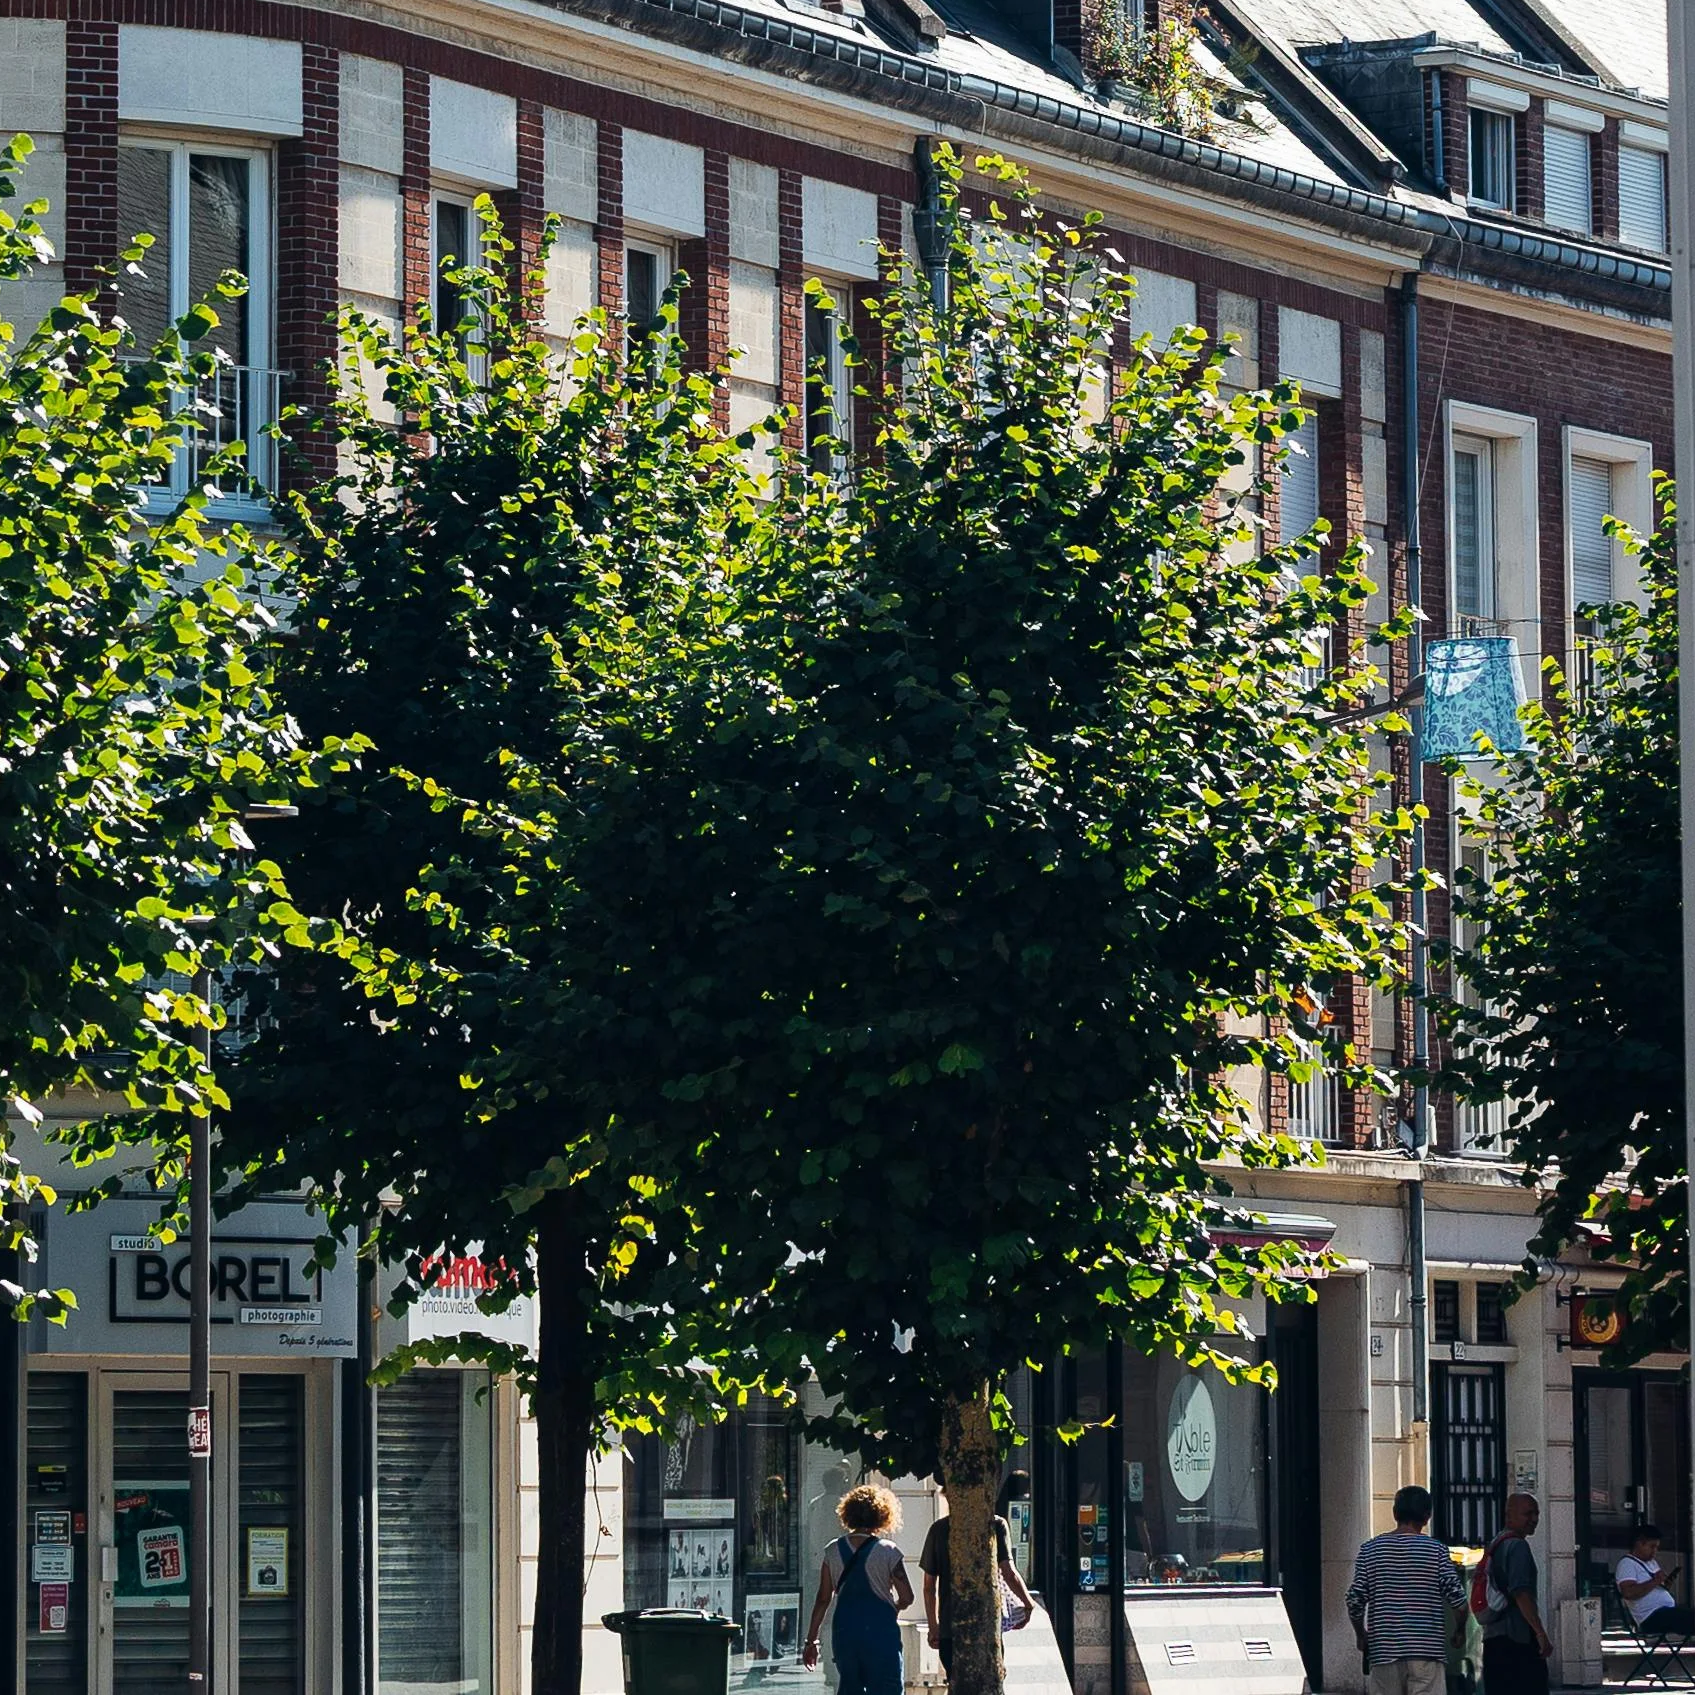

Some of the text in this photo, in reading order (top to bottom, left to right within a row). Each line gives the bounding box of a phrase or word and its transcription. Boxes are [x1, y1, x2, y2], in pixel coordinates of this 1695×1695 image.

[118, 1237, 155, 1250] studio
[136, 1254, 310, 1302] BOREL
[248, 1310, 316, 1323] photographie
[145, 1551, 160, 1574] 2
